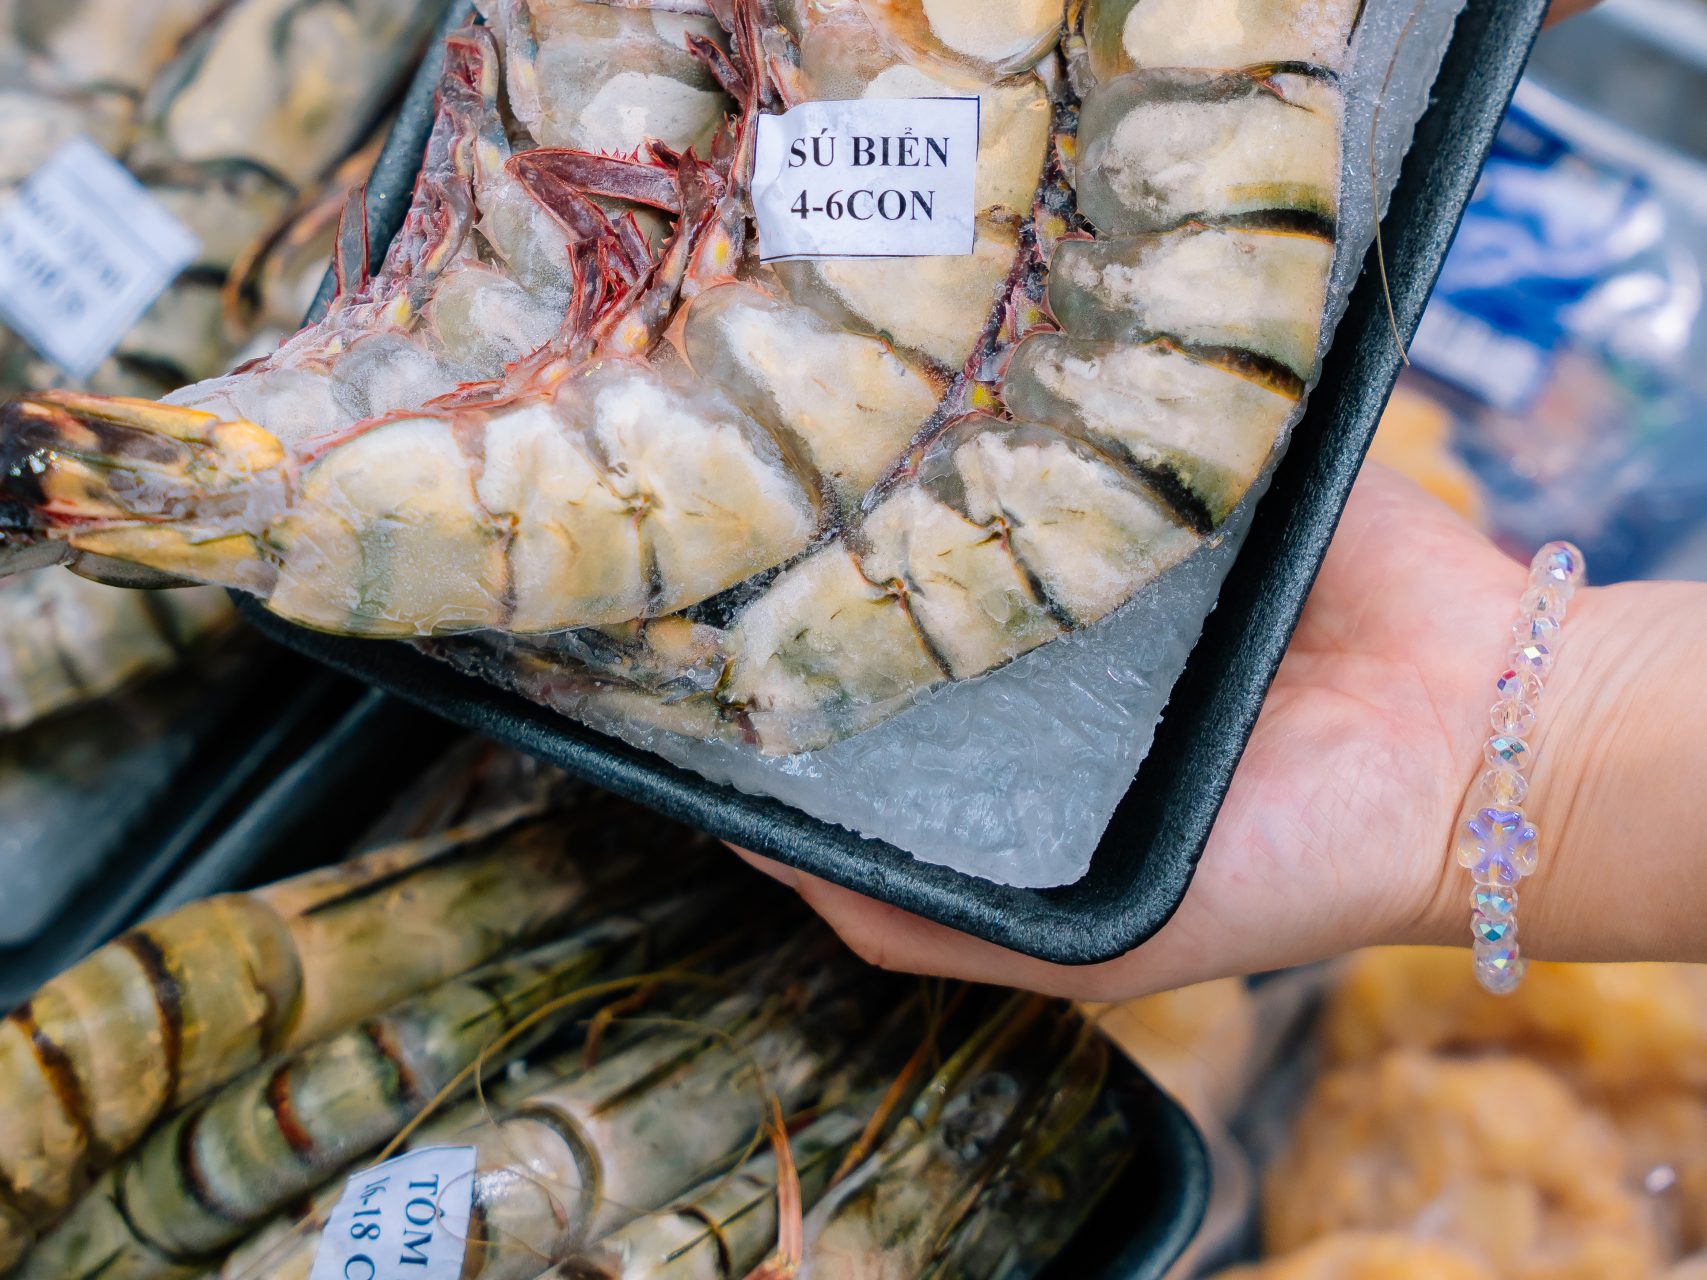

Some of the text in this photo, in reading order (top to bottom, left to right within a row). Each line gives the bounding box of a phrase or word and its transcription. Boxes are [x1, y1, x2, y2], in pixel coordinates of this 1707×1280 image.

[788, 126, 950, 168] SÚ BIỂN
[790, 189, 936, 221] 4-6CON
[400, 1173, 446, 1267] TÔM
